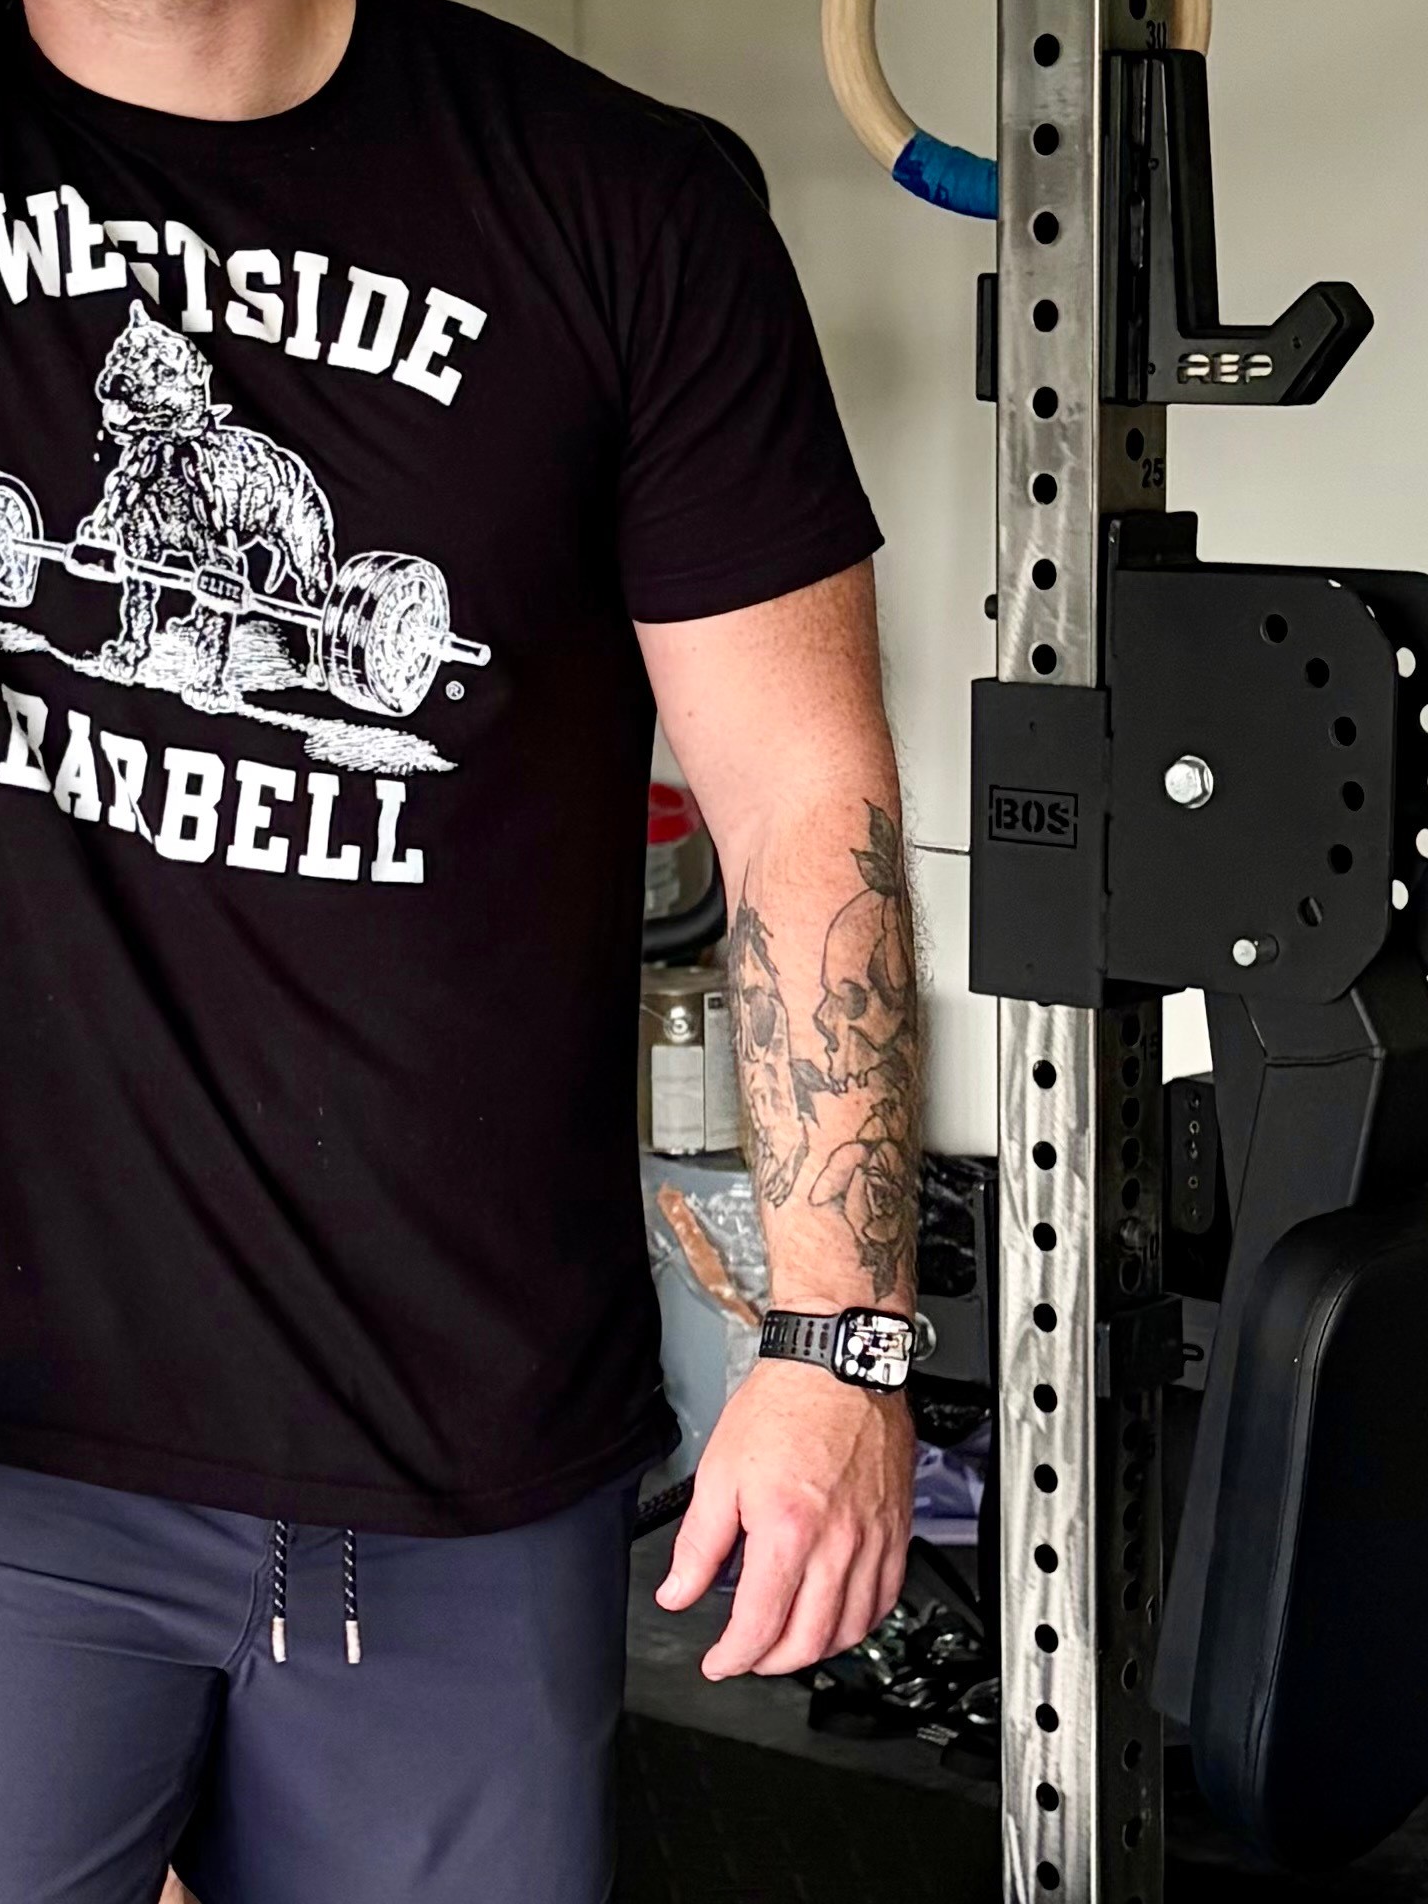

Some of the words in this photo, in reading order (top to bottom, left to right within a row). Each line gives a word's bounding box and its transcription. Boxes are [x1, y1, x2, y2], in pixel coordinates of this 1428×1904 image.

[1177, 352, 1273, 384] REP
[1141, 457, 1165, 489] 25
[995, 796, 1070, 835] BOS
